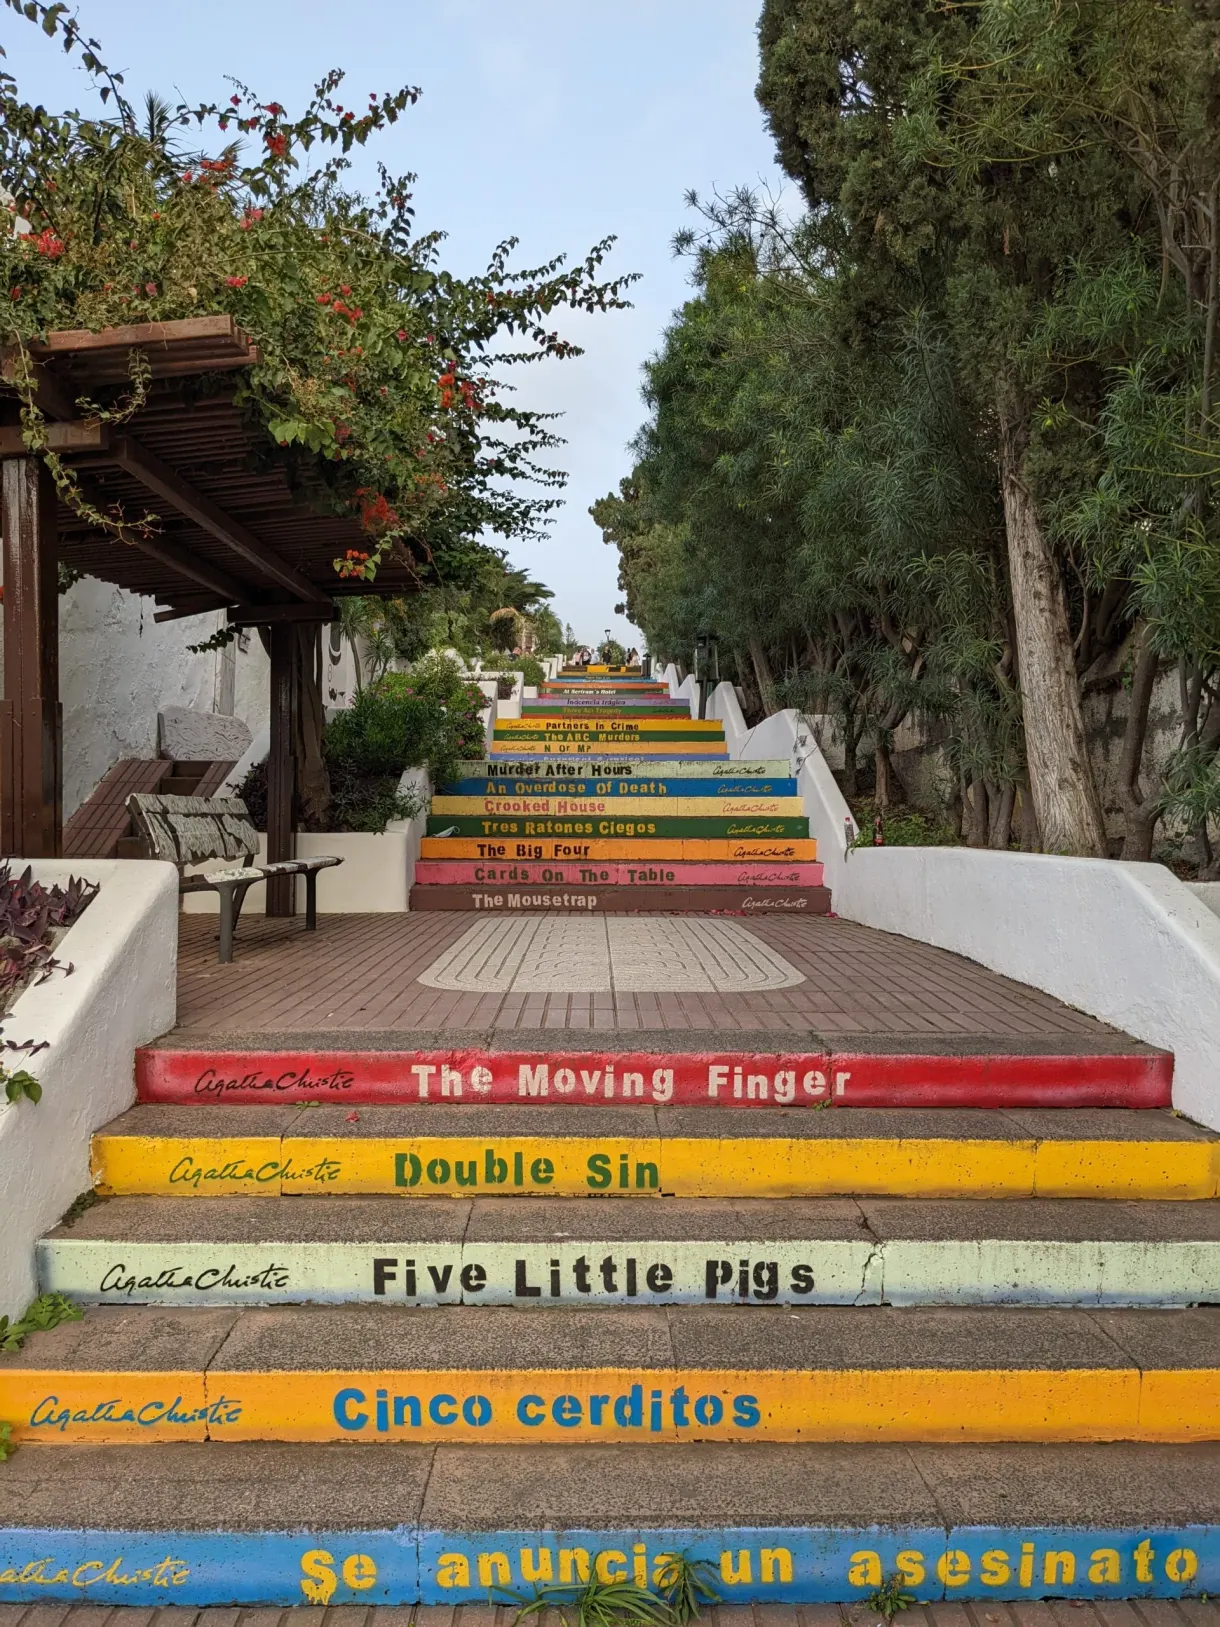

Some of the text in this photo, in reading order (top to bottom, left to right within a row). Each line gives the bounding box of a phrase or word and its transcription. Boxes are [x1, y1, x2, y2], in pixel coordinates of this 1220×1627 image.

[596, 722, 605, 730] In
[611, 722, 639, 730] Crime
[544, 733, 640, 741] The ABC Murders
[487, 764, 632, 776] Murder After Hours
[486, 781, 668, 795] An Overdose Of Death
[484, 800, 606, 813] Crooked House
[482, 821, 656, 836] Tres Ratones Ciegos
[477, 844, 590, 858] The Big Four
[475, 867, 676, 883] Cards On The Table
[472, 894, 597, 909] The Mousetrap
[411, 1064, 852, 1103] The Moving Finger
[394, 1149, 660, 1188] Double Sin
[373, 1258, 487, 1296] Five
[515, 1255, 674, 1297] Little
[333, 1384, 761, 1432] Cinco cerditos
[0, 1557, 69, 1585] atha
[301, 1538, 1198, 1605] Se anuncia un asesinato
